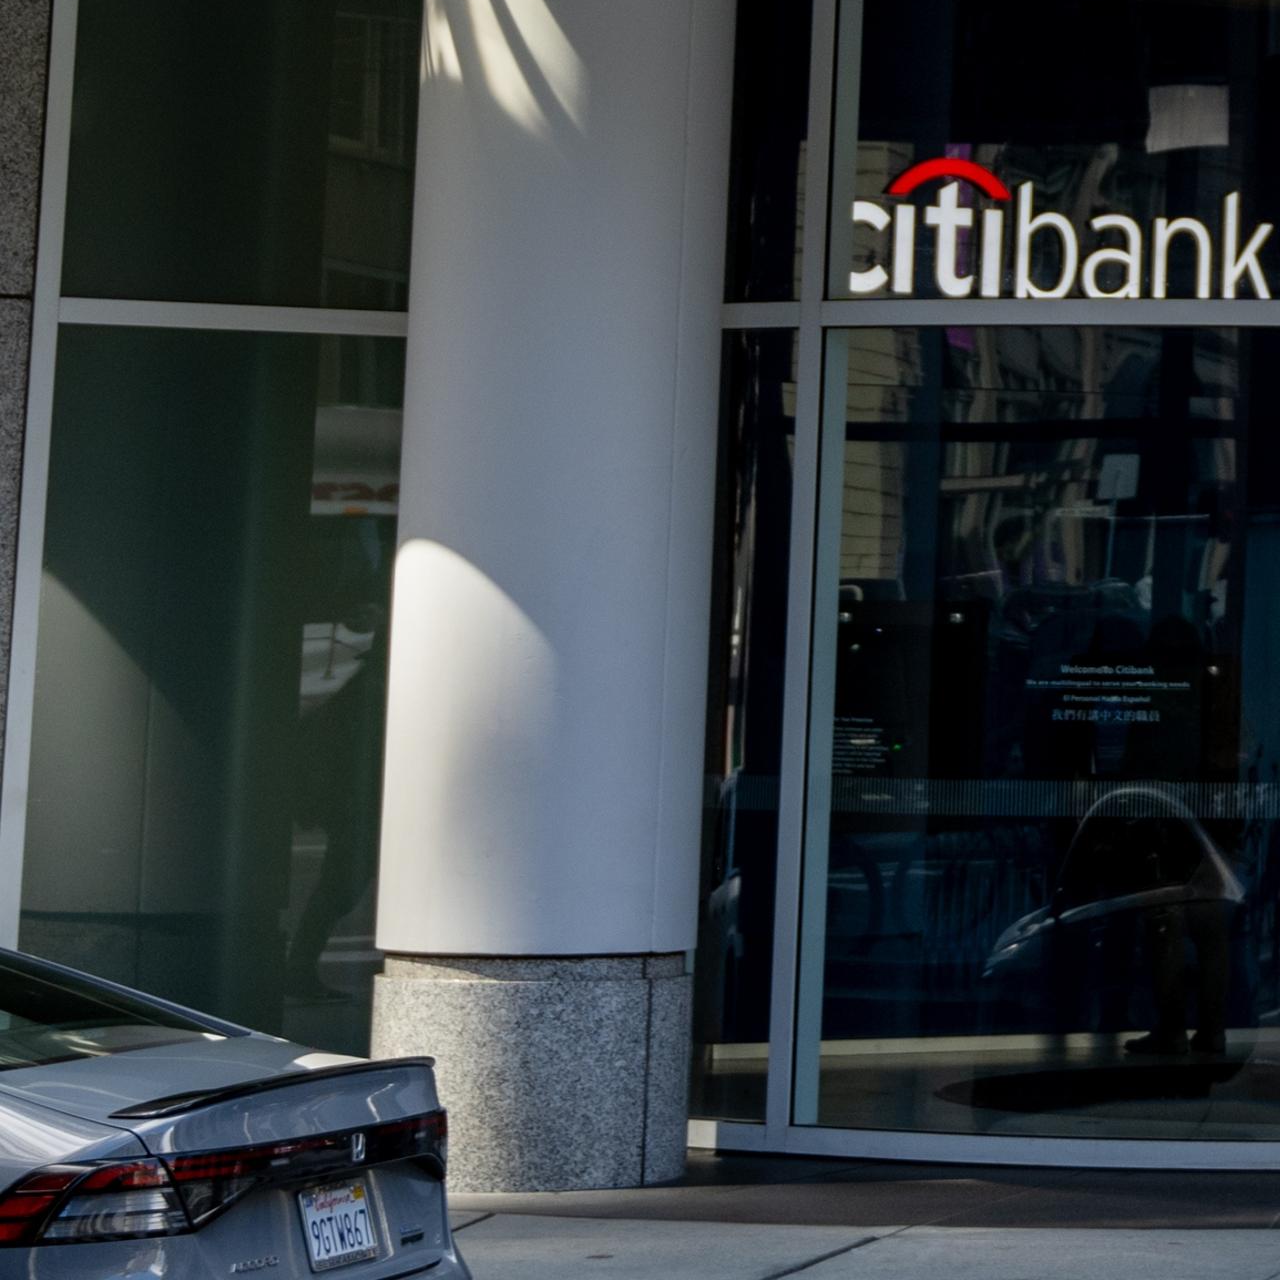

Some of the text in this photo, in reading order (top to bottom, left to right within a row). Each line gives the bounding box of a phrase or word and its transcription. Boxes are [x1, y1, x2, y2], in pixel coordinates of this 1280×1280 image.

[849, 180, 1274, 300] citibank
[1115, 665, 1156, 676] Citibank
[311, 1209, 372, 1257] 9GTW867
